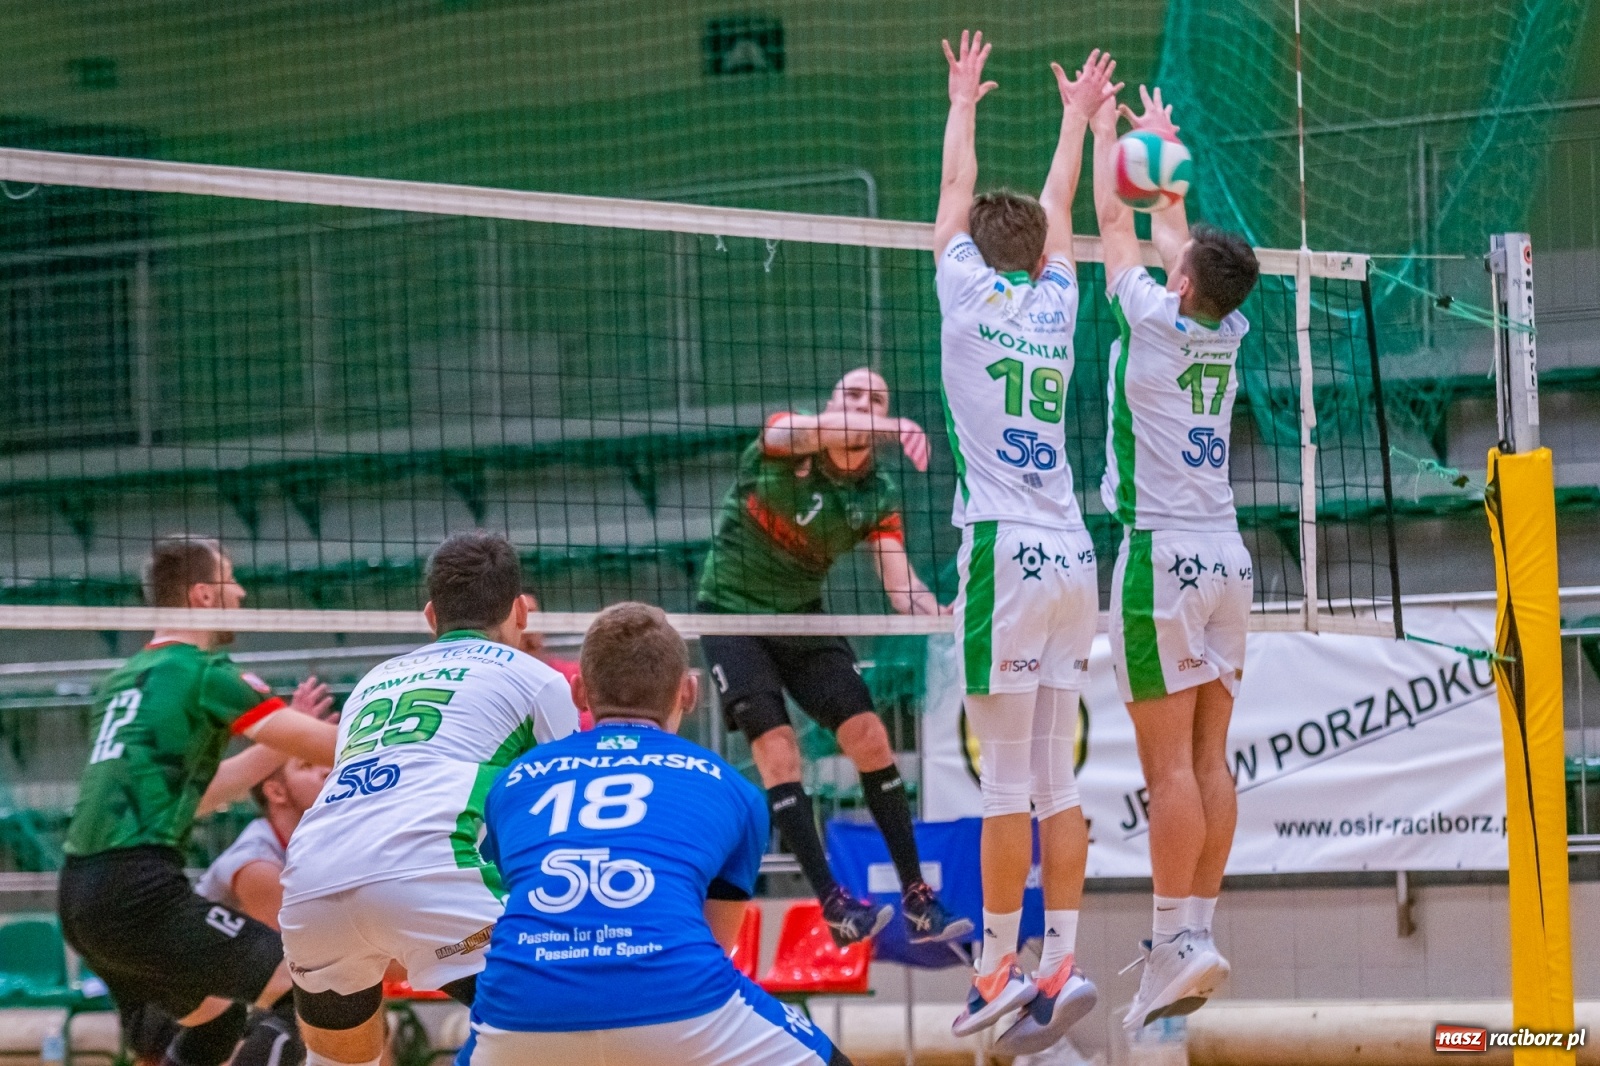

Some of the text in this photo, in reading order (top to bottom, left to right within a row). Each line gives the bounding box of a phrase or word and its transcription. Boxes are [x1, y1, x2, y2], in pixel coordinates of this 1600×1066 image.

[979, 323, 1068, 360] WOŹNIAK
[985, 357, 1064, 424] 19
[1176, 363, 1231, 416] 17
[361, 668, 471, 701] PAWICKI
[90, 688, 143, 765] 12
[336, 688, 456, 766] 25
[1268, 657, 1497, 771] PORZĄDKU
[505, 753, 722, 788] ŚWINIARSKI
[528, 773, 654, 836] 18
[205, 905, 246, 939] 12
[517, 930, 570, 946] Passion
[596, 923, 633, 944] glass
[535, 945, 590, 962] Passion
[593, 944, 613, 957] for
